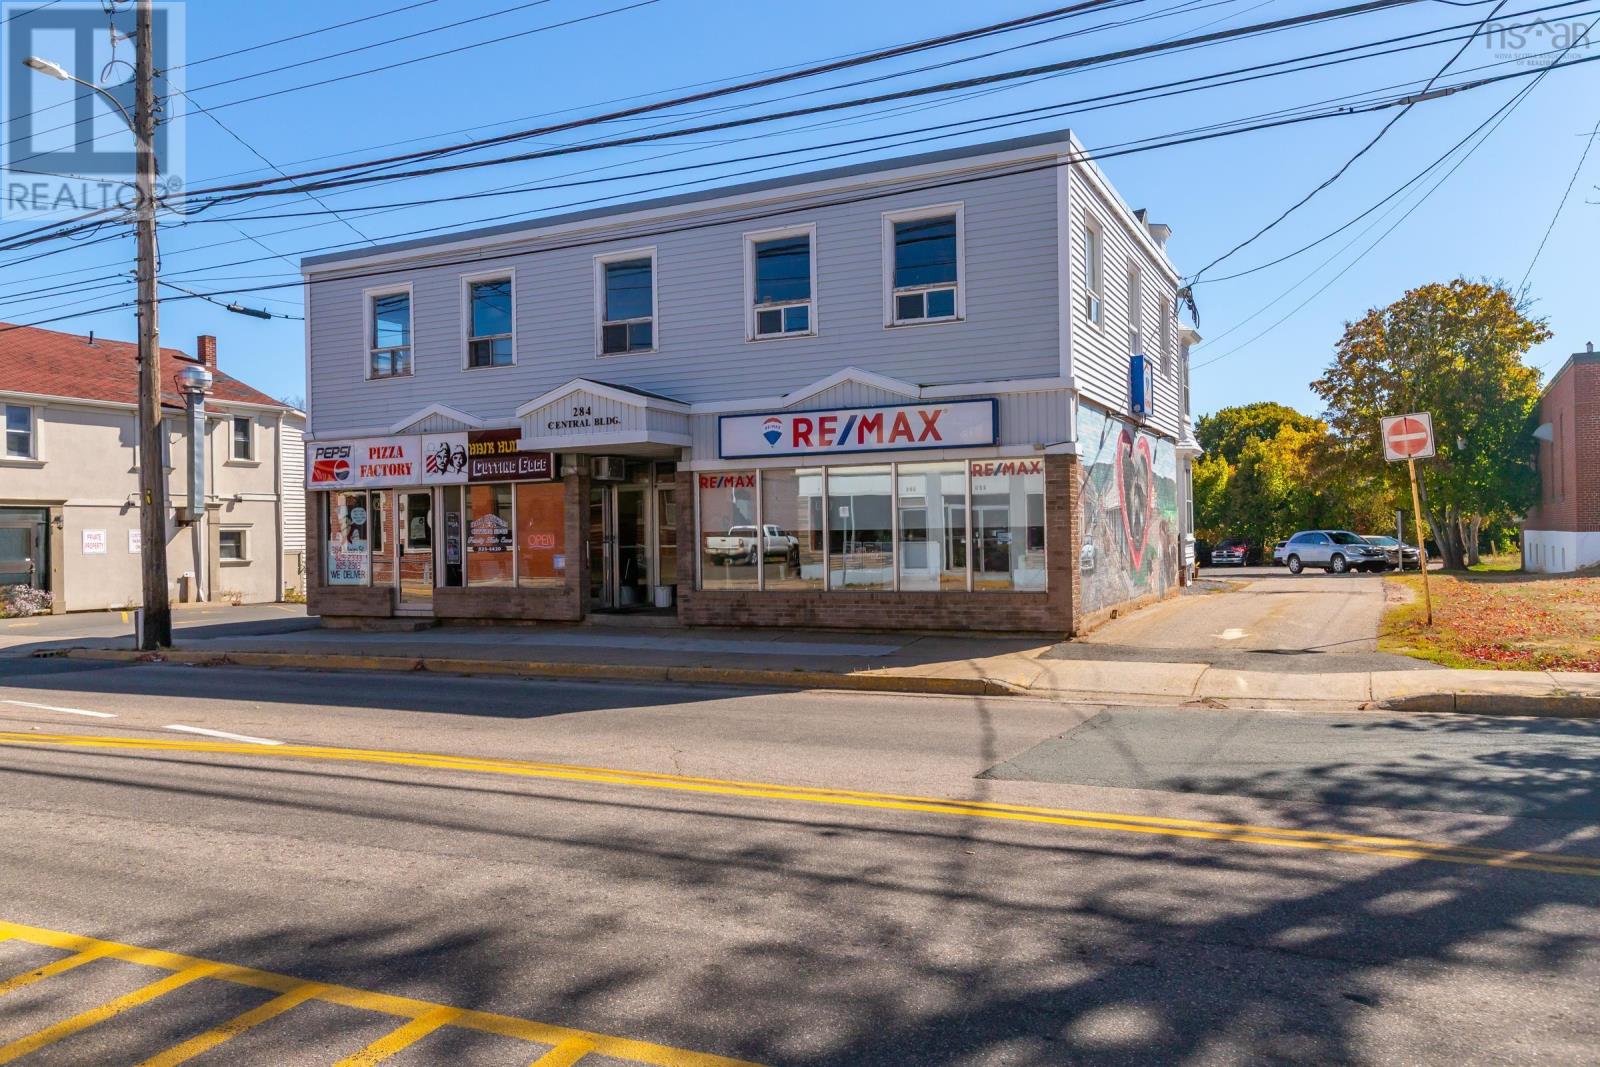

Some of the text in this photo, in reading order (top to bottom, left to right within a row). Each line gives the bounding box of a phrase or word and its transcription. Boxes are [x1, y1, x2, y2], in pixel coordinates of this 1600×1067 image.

[573, 406, 592, 417] 284
[548, 416, 622, 430] CENTRAL BLDG.
[793, 409, 943, 448] RE/MAX
[316, 446, 351, 459] PEPSI
[369, 446, 404, 460] PIZZA
[360, 463, 413, 478] FACTORY
[519, 457, 547, 474] EDGE
[973, 461, 1041, 477] RE/MAX
[700, 475, 754, 489] RE/MAX
[528, 534, 555, 546] OPEN
[331, 570, 341, 579] WE
